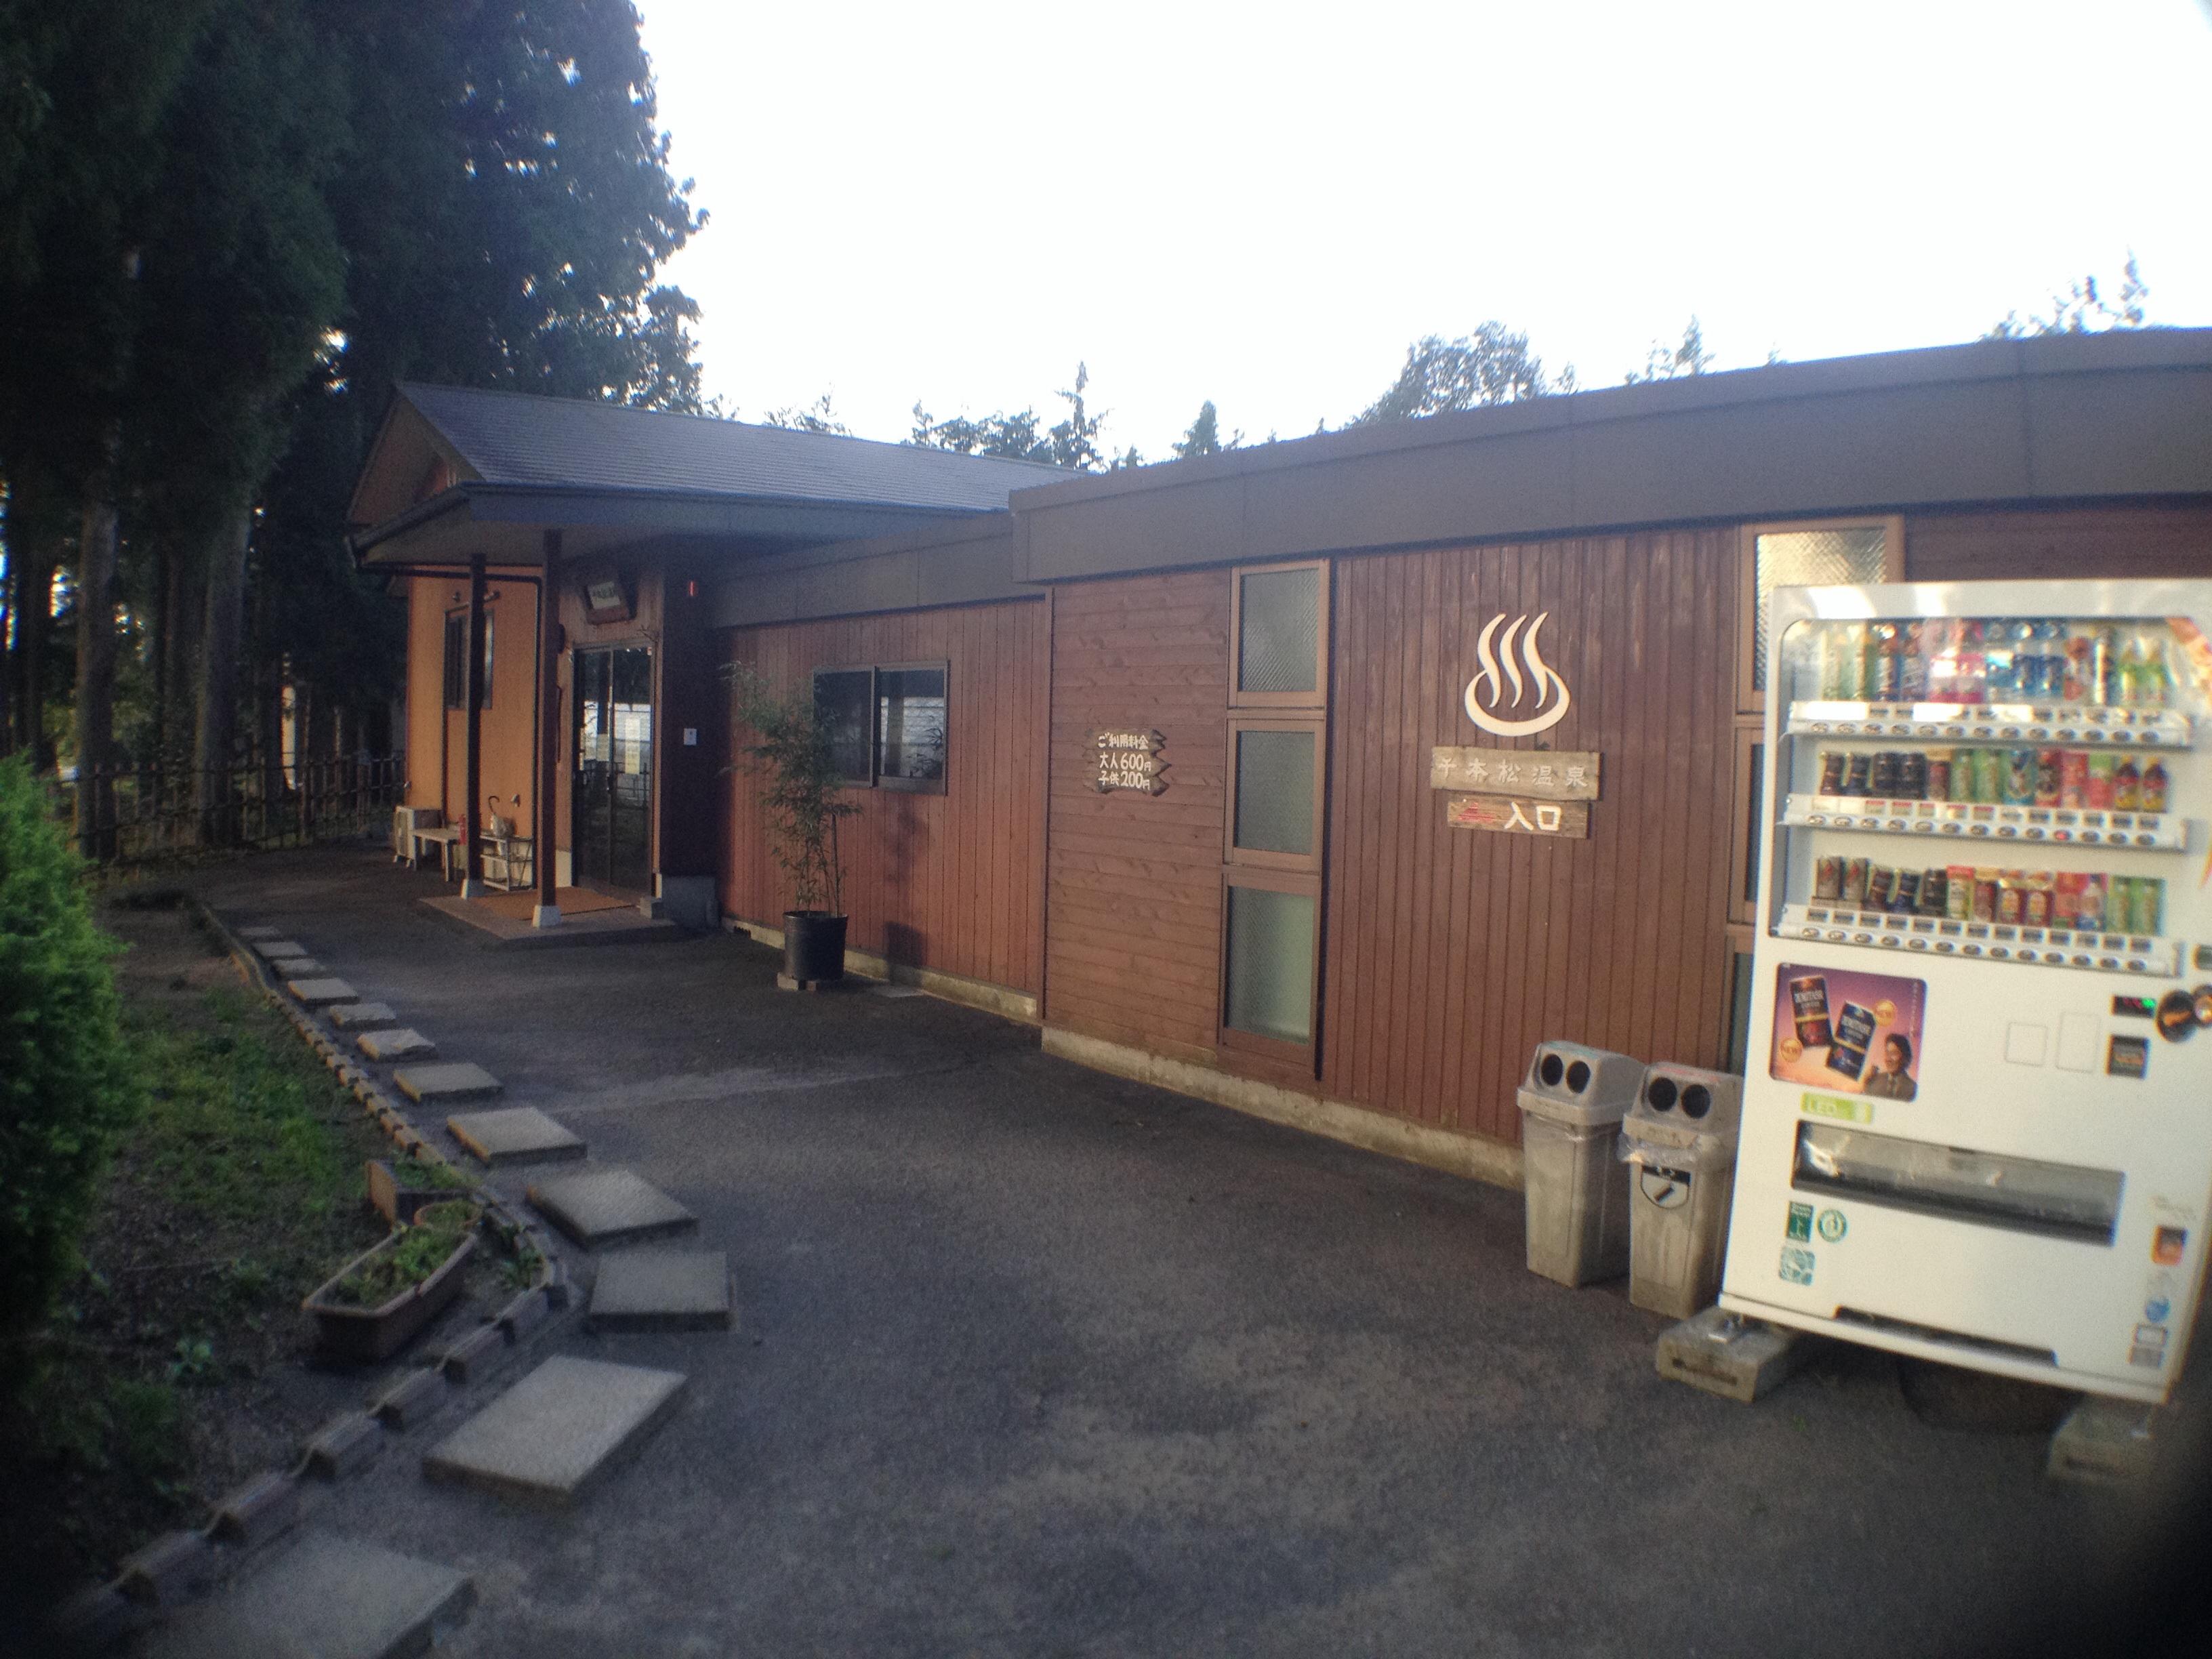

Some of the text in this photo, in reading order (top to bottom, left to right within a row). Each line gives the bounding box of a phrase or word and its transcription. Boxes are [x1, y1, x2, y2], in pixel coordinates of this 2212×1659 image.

[1098, 733, 1149, 750] ご利用料金
[1437, 758, 1588, 787] 千本松温泉
[1504, 801, 1562, 832] 入口
